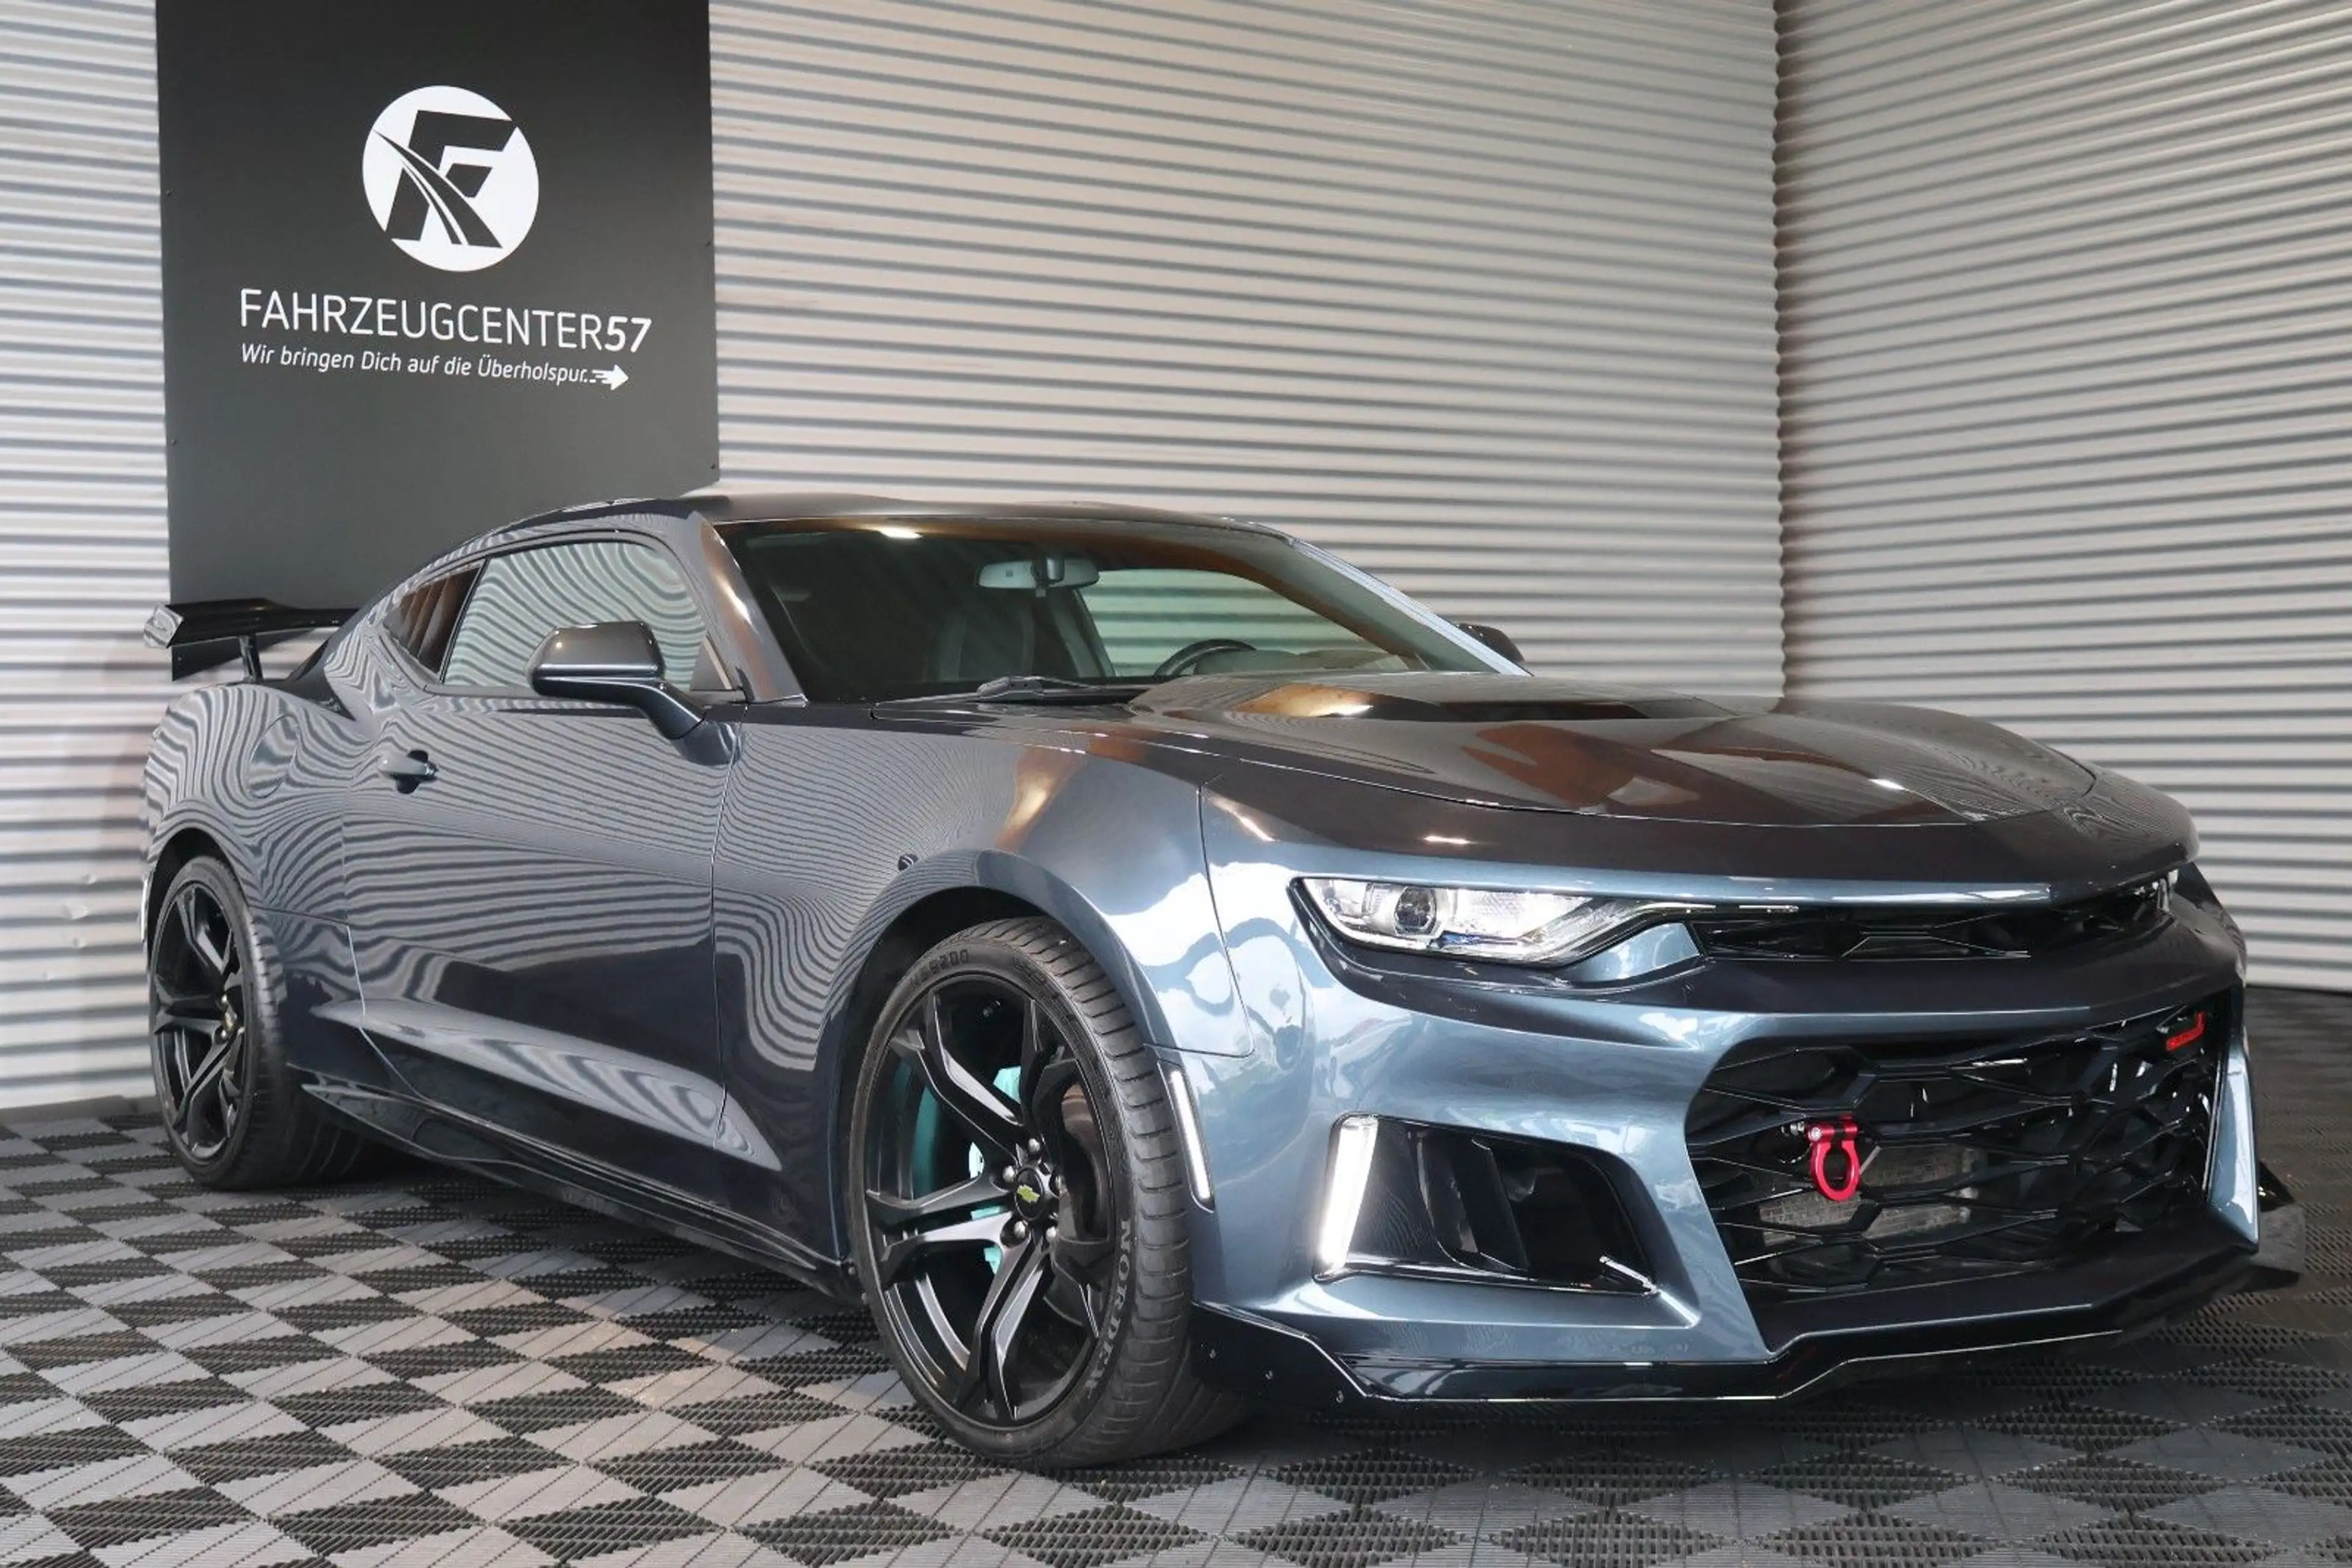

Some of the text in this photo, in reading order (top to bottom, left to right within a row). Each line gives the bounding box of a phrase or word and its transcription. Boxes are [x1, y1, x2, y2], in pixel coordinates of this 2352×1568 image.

[240, 287, 653, 354] FAHRZEUGCENTER57
[241, 342, 275, 364] Wir
[281, 345, 355, 373] bringen
[361, 350, 402, 372] Dich
[407, 354, 440, 374] auf
[444, 355, 472, 377] die
